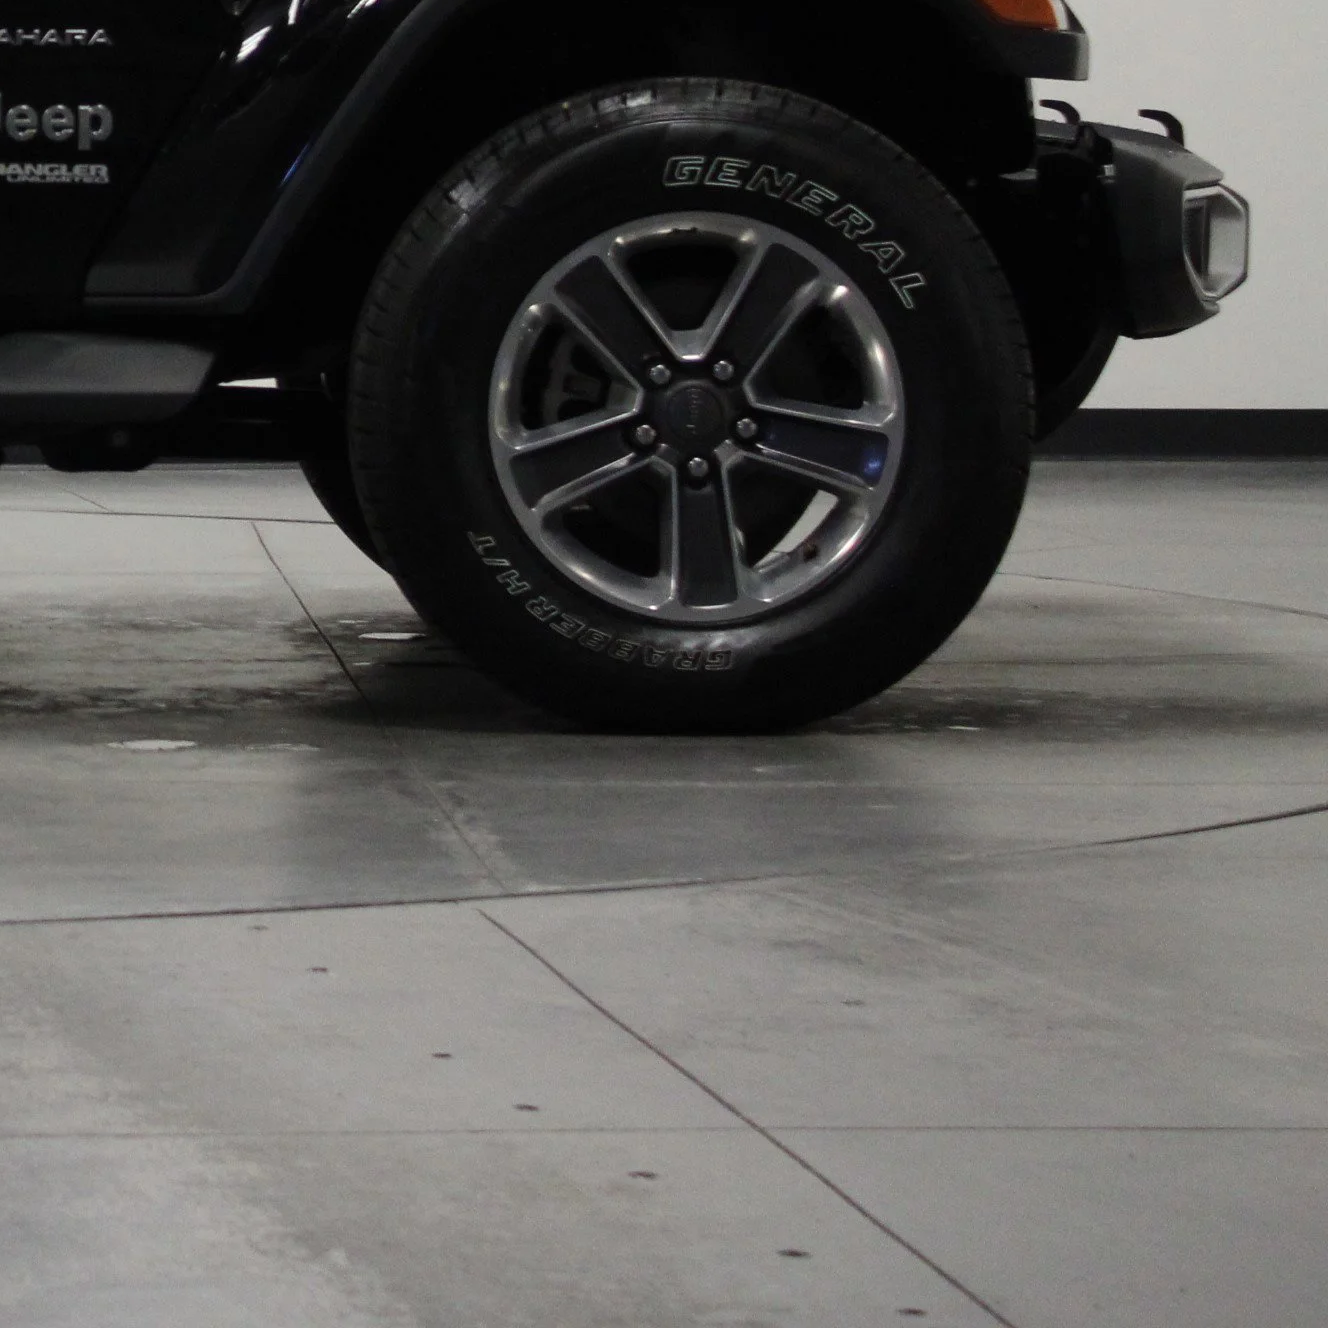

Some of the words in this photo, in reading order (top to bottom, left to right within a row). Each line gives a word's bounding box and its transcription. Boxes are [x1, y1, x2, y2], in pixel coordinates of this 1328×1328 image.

[662, 155, 928, 310] GENERAL
[466, 530, 531, 596] H/T
[525, 594, 735, 671] GRABBER
